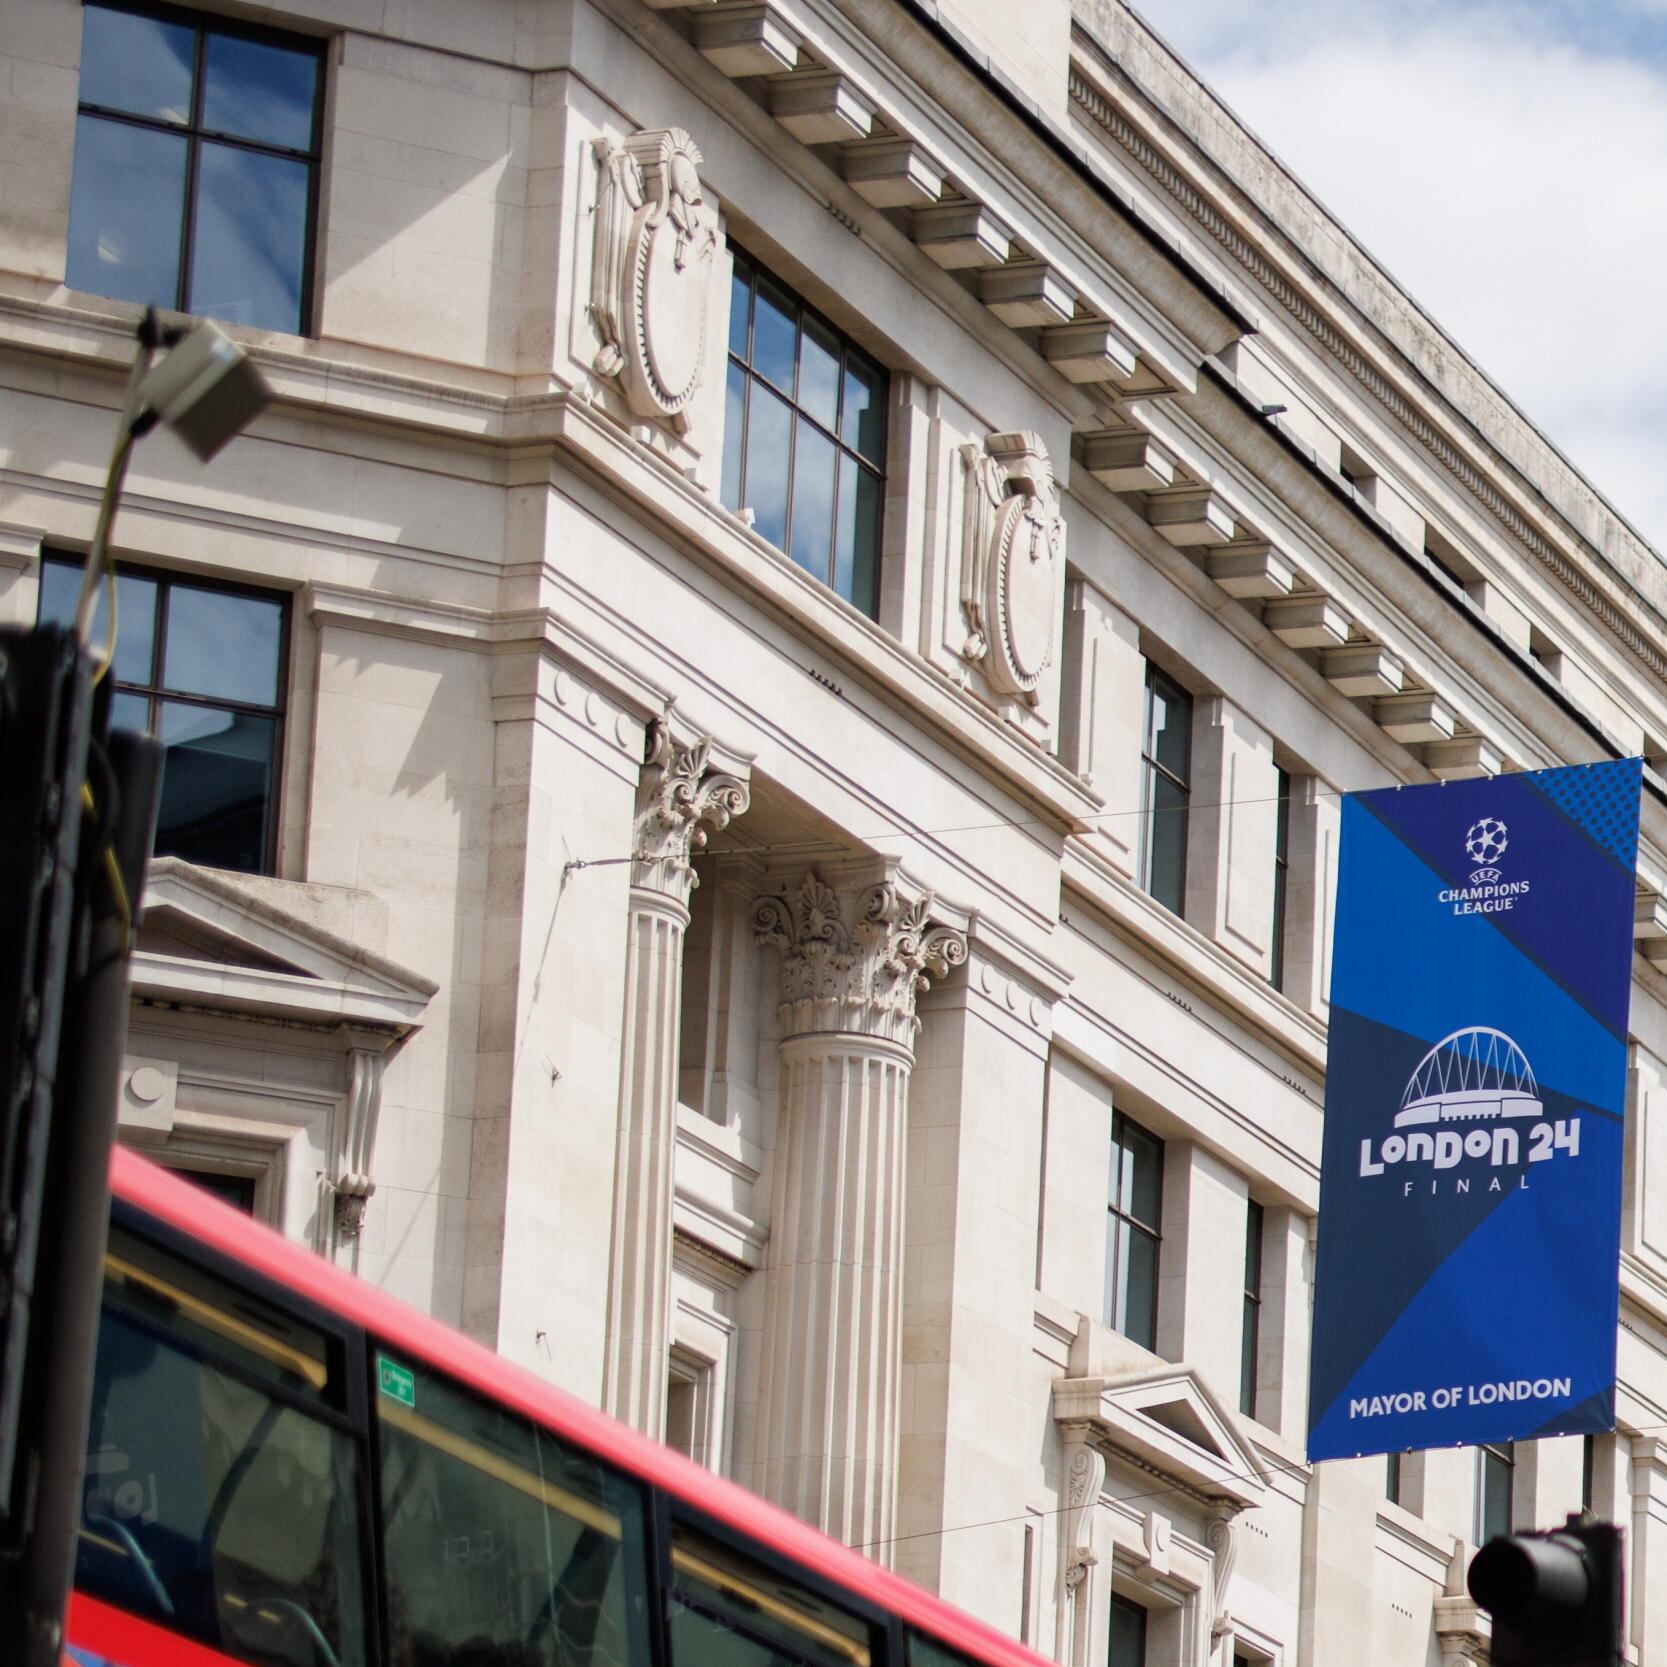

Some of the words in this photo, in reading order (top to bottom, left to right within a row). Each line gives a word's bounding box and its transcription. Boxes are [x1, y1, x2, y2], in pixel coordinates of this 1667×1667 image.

[1470, 868, 1502, 885] UEFA
[1438, 880, 1530, 903] CHAMPIONS
[1453, 897, 1515, 916] LEAGUE
[1529, 1118, 1581, 1162] 24
[1404, 1176, 1530, 1197] FINAL
[1349, 1389, 1427, 1419] MAYOR
[1431, 1386, 1463, 1409] OF
[1468, 1377, 1571, 1405] LONDON
